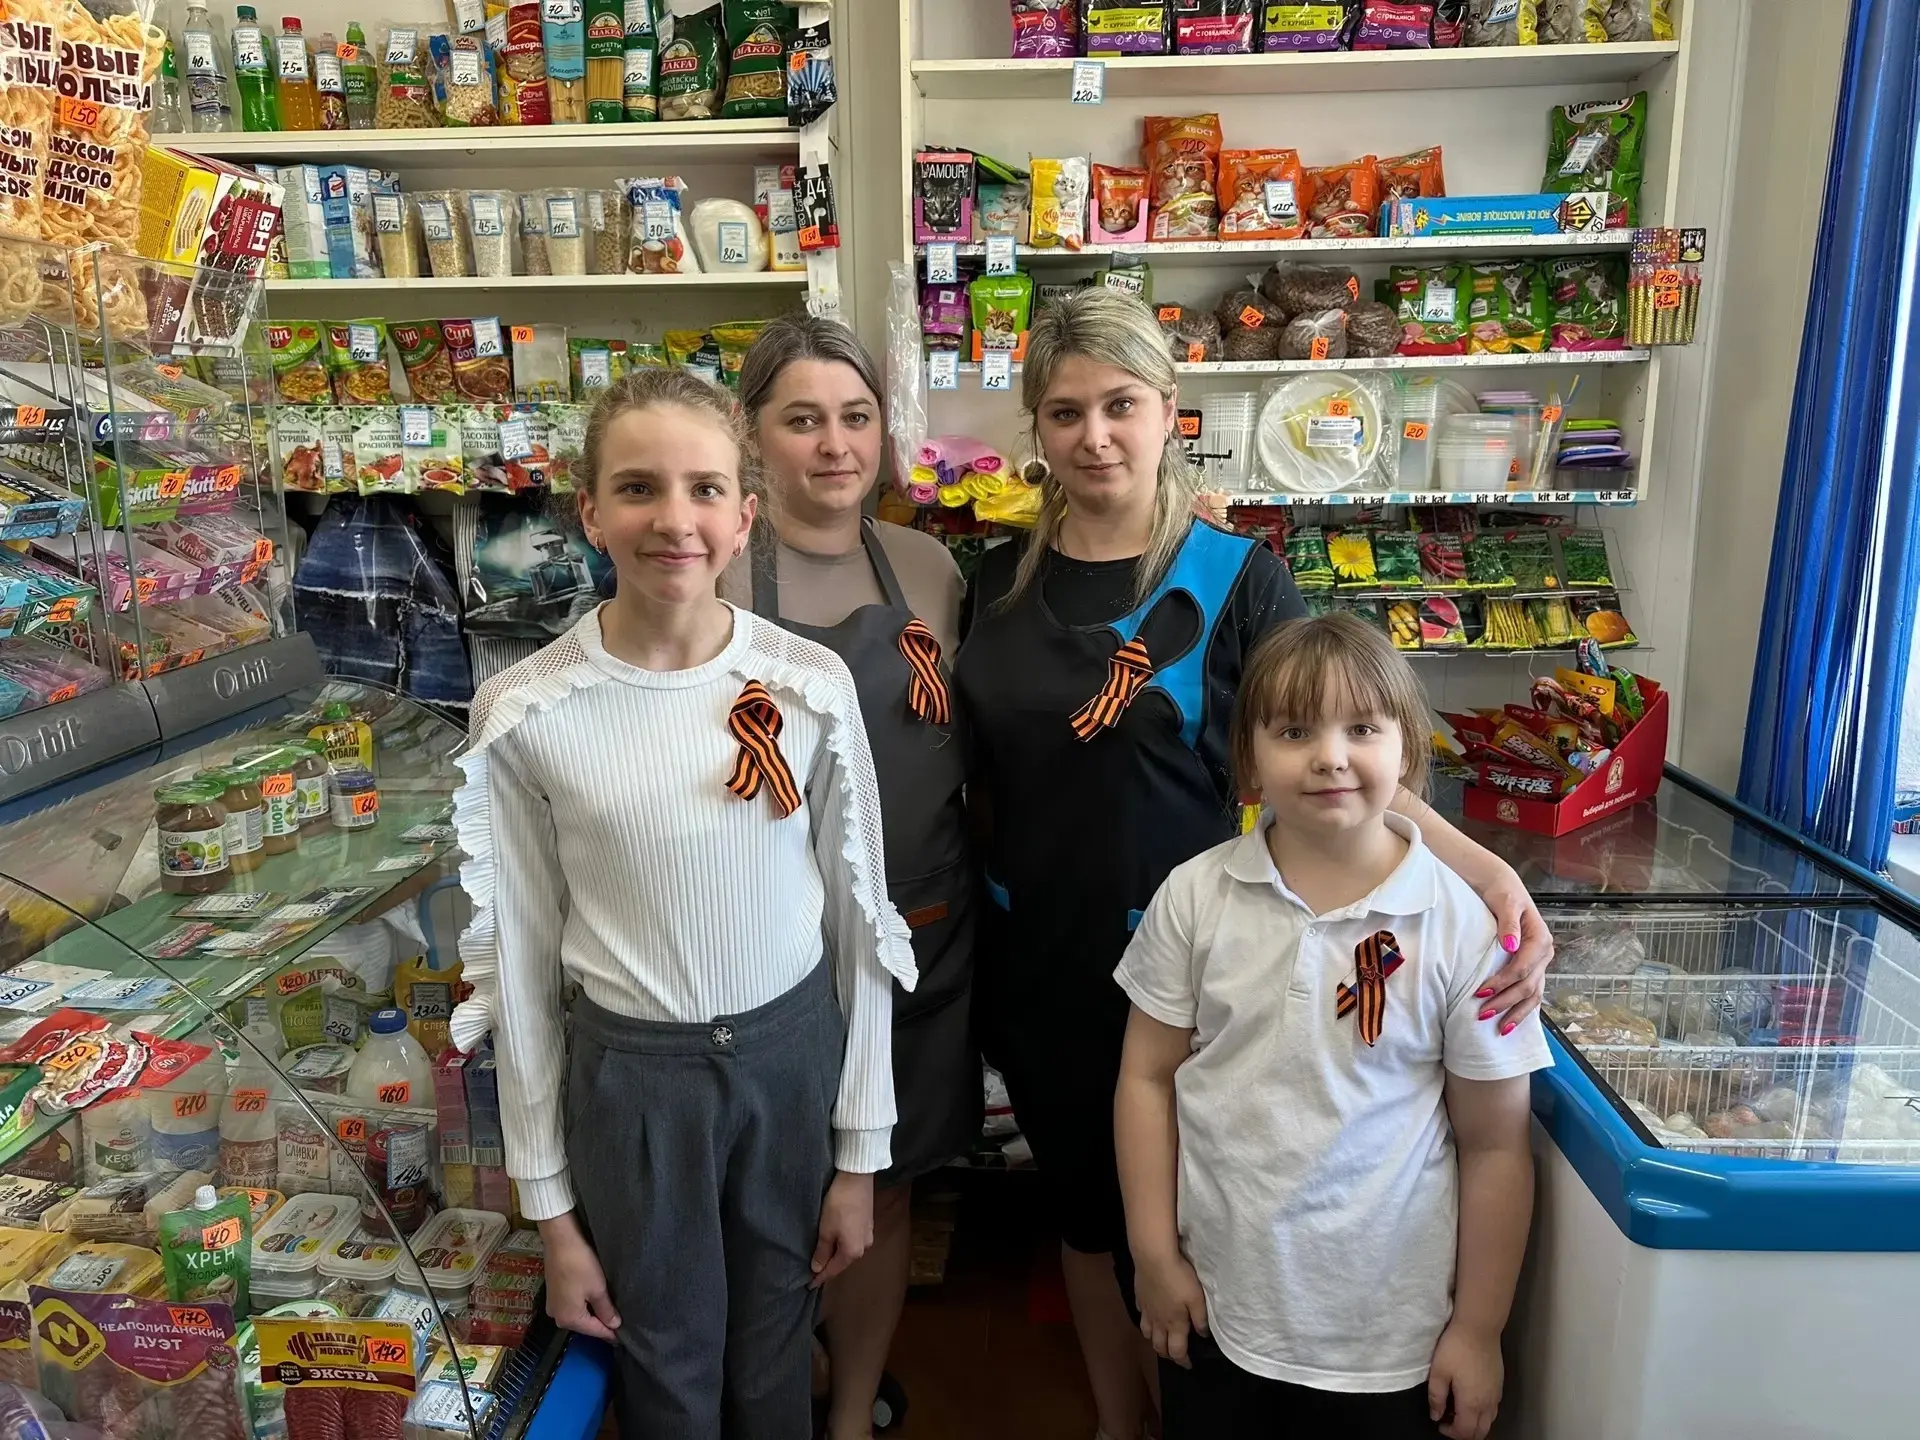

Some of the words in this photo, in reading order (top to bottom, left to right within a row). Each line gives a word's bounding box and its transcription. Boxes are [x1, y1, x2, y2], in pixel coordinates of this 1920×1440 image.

[549, 5, 563, 14] 70
[736, 44, 777, 57] MAKFA
[66, 105, 97, 125] 150
[1184, 125, 1214, 137] ХВОСТ
[806, 177, 827, 200] A4
[1455, 211, 1481, 222] BOBINE
[1482, 211, 1525, 221] MOUSTIQUE
[1107, 276, 1143, 293] kitekat
[157, 295, 171, 333] ДЕСЕРТА
[396, 327, 418, 346] Суп
[444, 326, 472, 346] Суп
[514, 329, 526, 340] 10
[585, 375, 601, 386] 60
[1332, 403, 1347, 415] 95
[1406, 427, 1423, 439] 20
[463, 441, 498, 449] СЕЛЬДИ
[220, 474, 234, 488] 70
[177, 539, 207, 562] White
[214, 656, 273, 699] Orbit
[265, 782, 286, 793] 110
[361, 798, 375, 813] 60
[272, 796, 284, 834] ПЮРЕ
[325, 1021, 352, 1037] 250
[382, 1087, 405, 1103] 160
[178, 1094, 206, 1113] 110
[346, 1122, 362, 1136] 69
[285, 1143, 318, 1161] СЛИВКИ
[394, 1163, 427, 1185] 145
[186, 1245, 236, 1270] ХРЕН
[186, 1263, 236, 1282] СТОЛОВЫЙ
[177, 1310, 208, 1325] 170
[99, 1321, 226, 1340] НЕАПОЛИТАНСКИЙ
[134, 1335, 182, 1351] ДУЭТ
[311, 1332, 358, 1345] ПАПА
[319, 1346, 356, 1357] МОЖЕТ
[374, 1343, 406, 1361] 170
[281, 1369, 301, 1378] №1
[309, 1368, 380, 1381] ЭКСТРА
